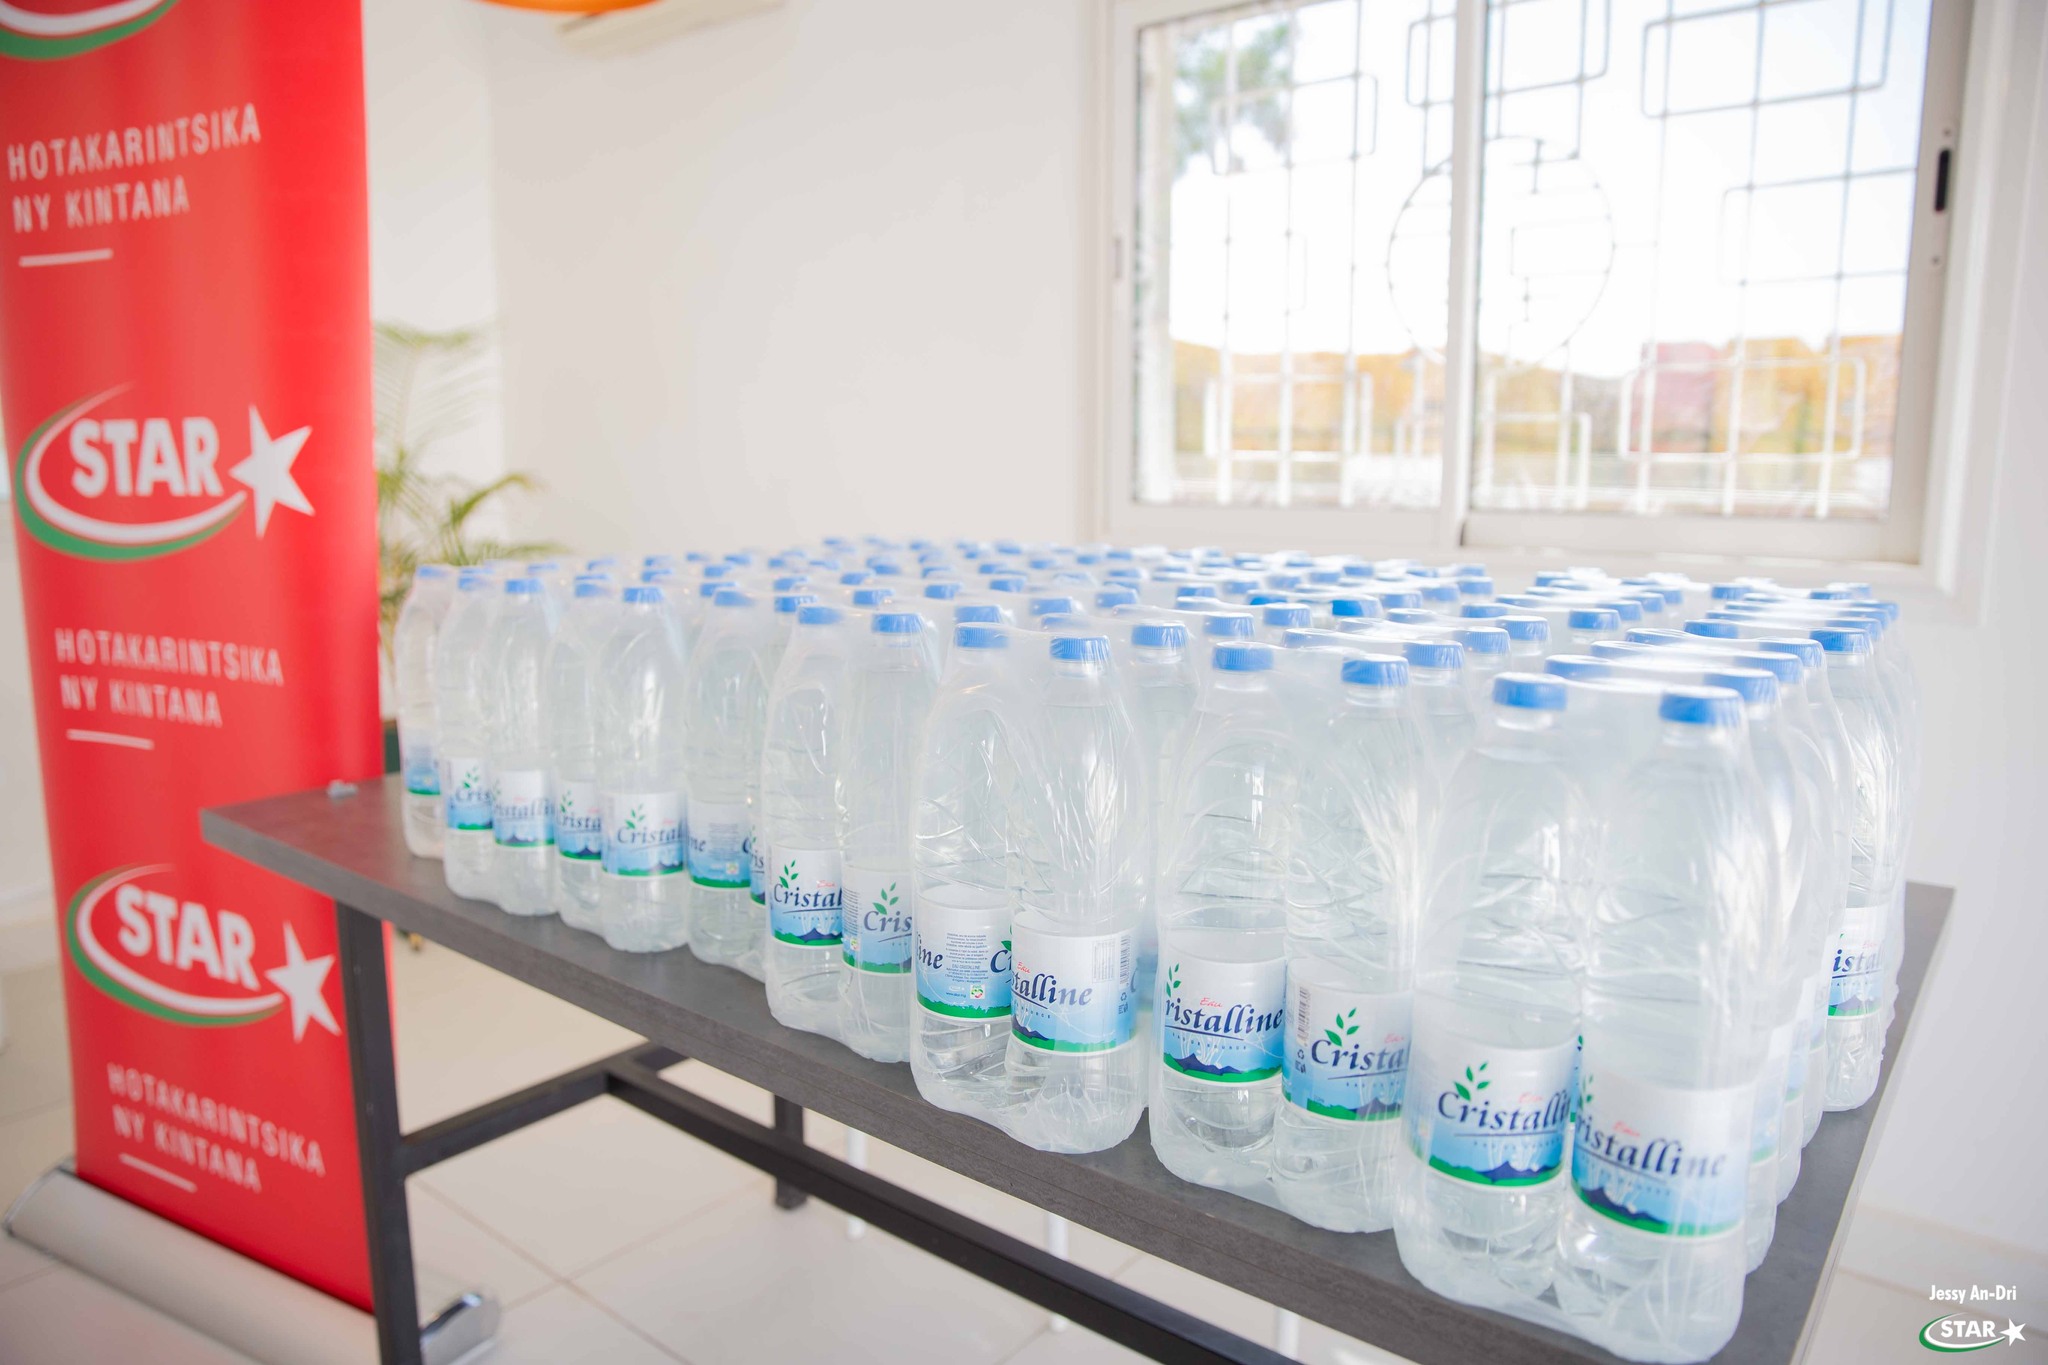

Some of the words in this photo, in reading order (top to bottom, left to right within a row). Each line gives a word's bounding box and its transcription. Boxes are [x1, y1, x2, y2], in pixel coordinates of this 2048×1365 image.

[7, 102, 261, 182] HOTAKARINTSIKA
[12, 193, 51, 233] NY
[65, 175, 190, 229] KINTANA
[69, 416, 224, 498] STAR
[55, 628, 284, 687] HOTAKARINTSIKA
[60, 675, 98, 709] NY
[109, 679, 223, 728] KINTANA
[116, 883, 260, 992] STAR
[107, 1061, 326, 1178] HOTAKARINTSIKA
[112, 1104, 145, 1142] NY
[153, 1120, 262, 1194] KINTANA
